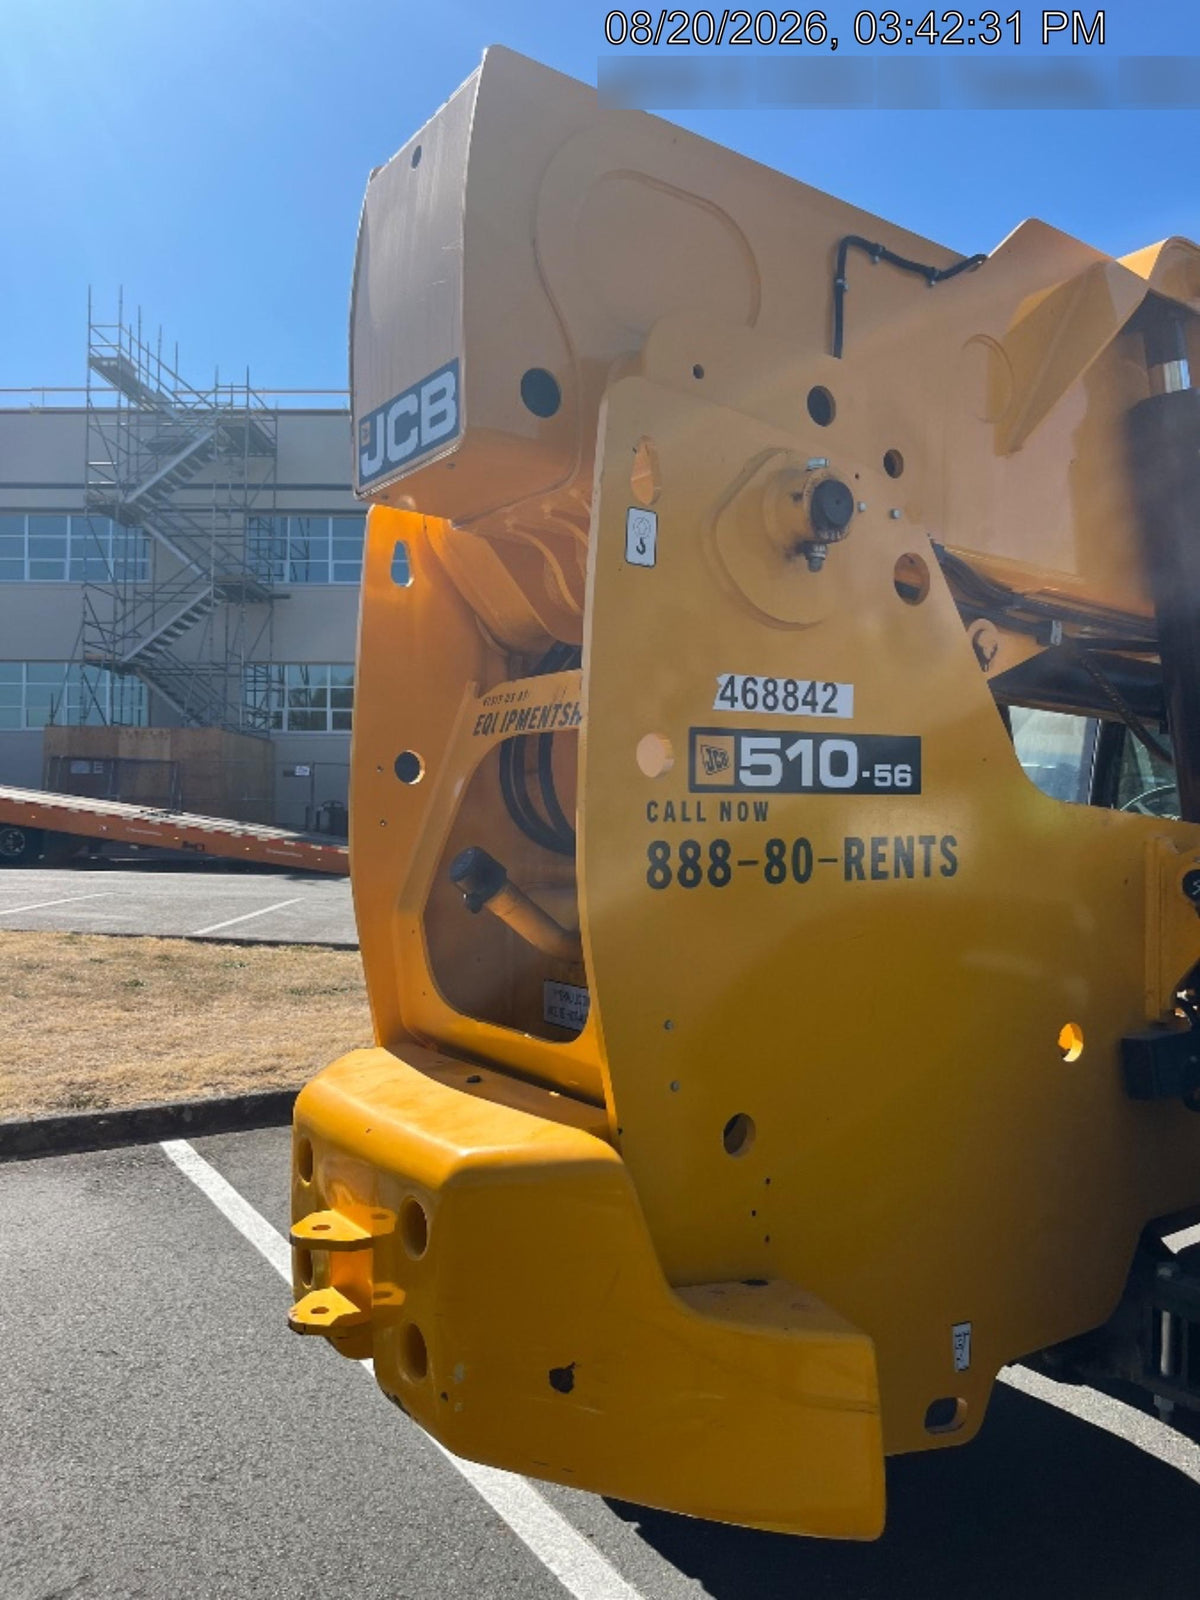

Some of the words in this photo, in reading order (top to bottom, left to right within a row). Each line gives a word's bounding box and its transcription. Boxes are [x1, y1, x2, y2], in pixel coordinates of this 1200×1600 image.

[360, 370, 458, 478] JCB
[718, 674, 839, 714] 468842
[646, 800, 707, 822] CALL
[719, 800, 770, 822] NOW
[646, 834, 959, 890] 888-80-RENTS
